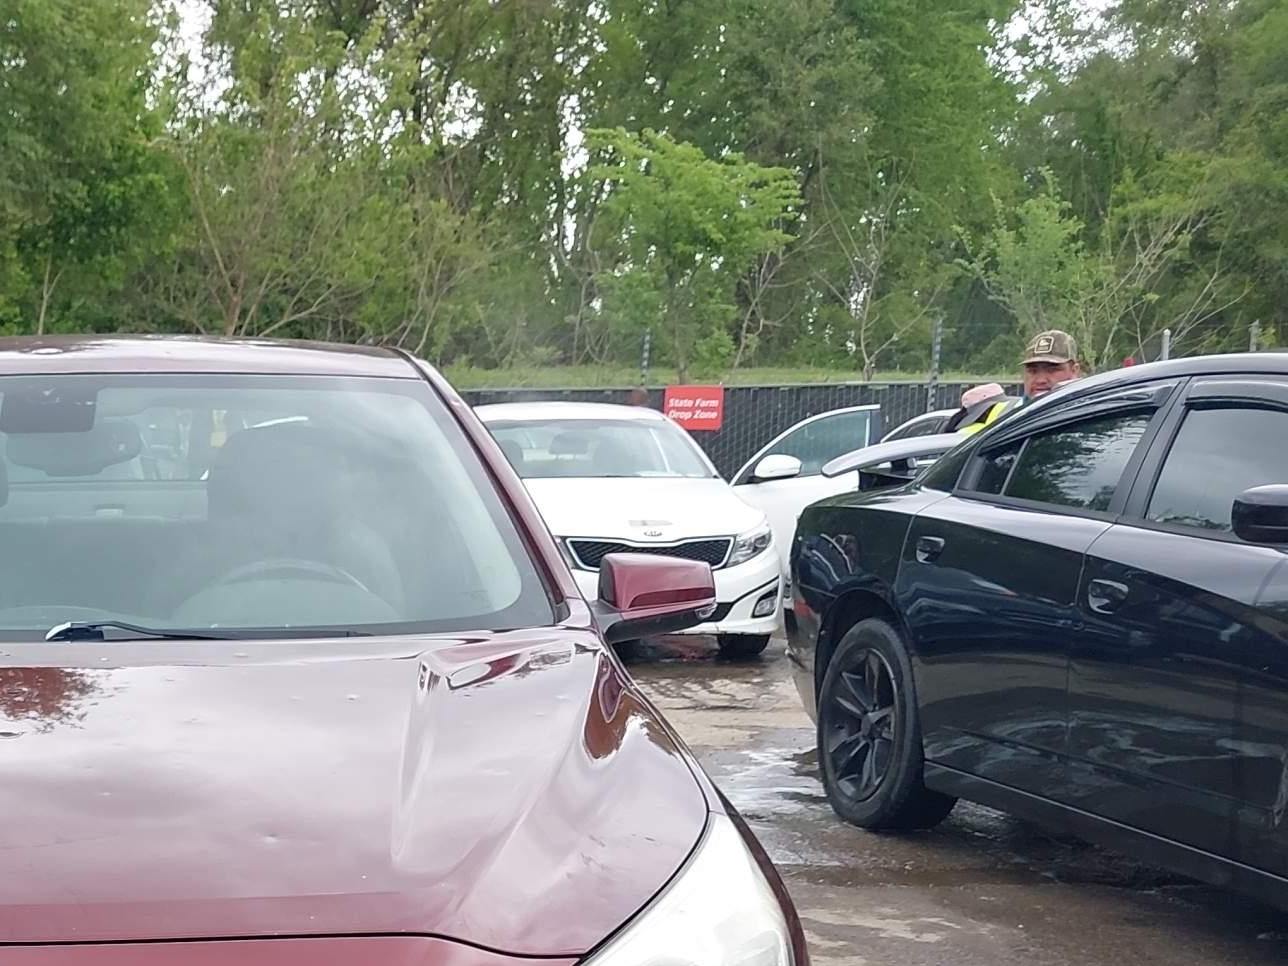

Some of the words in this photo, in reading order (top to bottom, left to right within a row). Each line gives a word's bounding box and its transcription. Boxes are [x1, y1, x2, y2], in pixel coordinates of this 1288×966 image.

[668, 398, 694, 408] State
[694, 398, 719, 408] Farm
[668, 410, 693, 421] Drop
[693, 410, 718, 419] Zone
